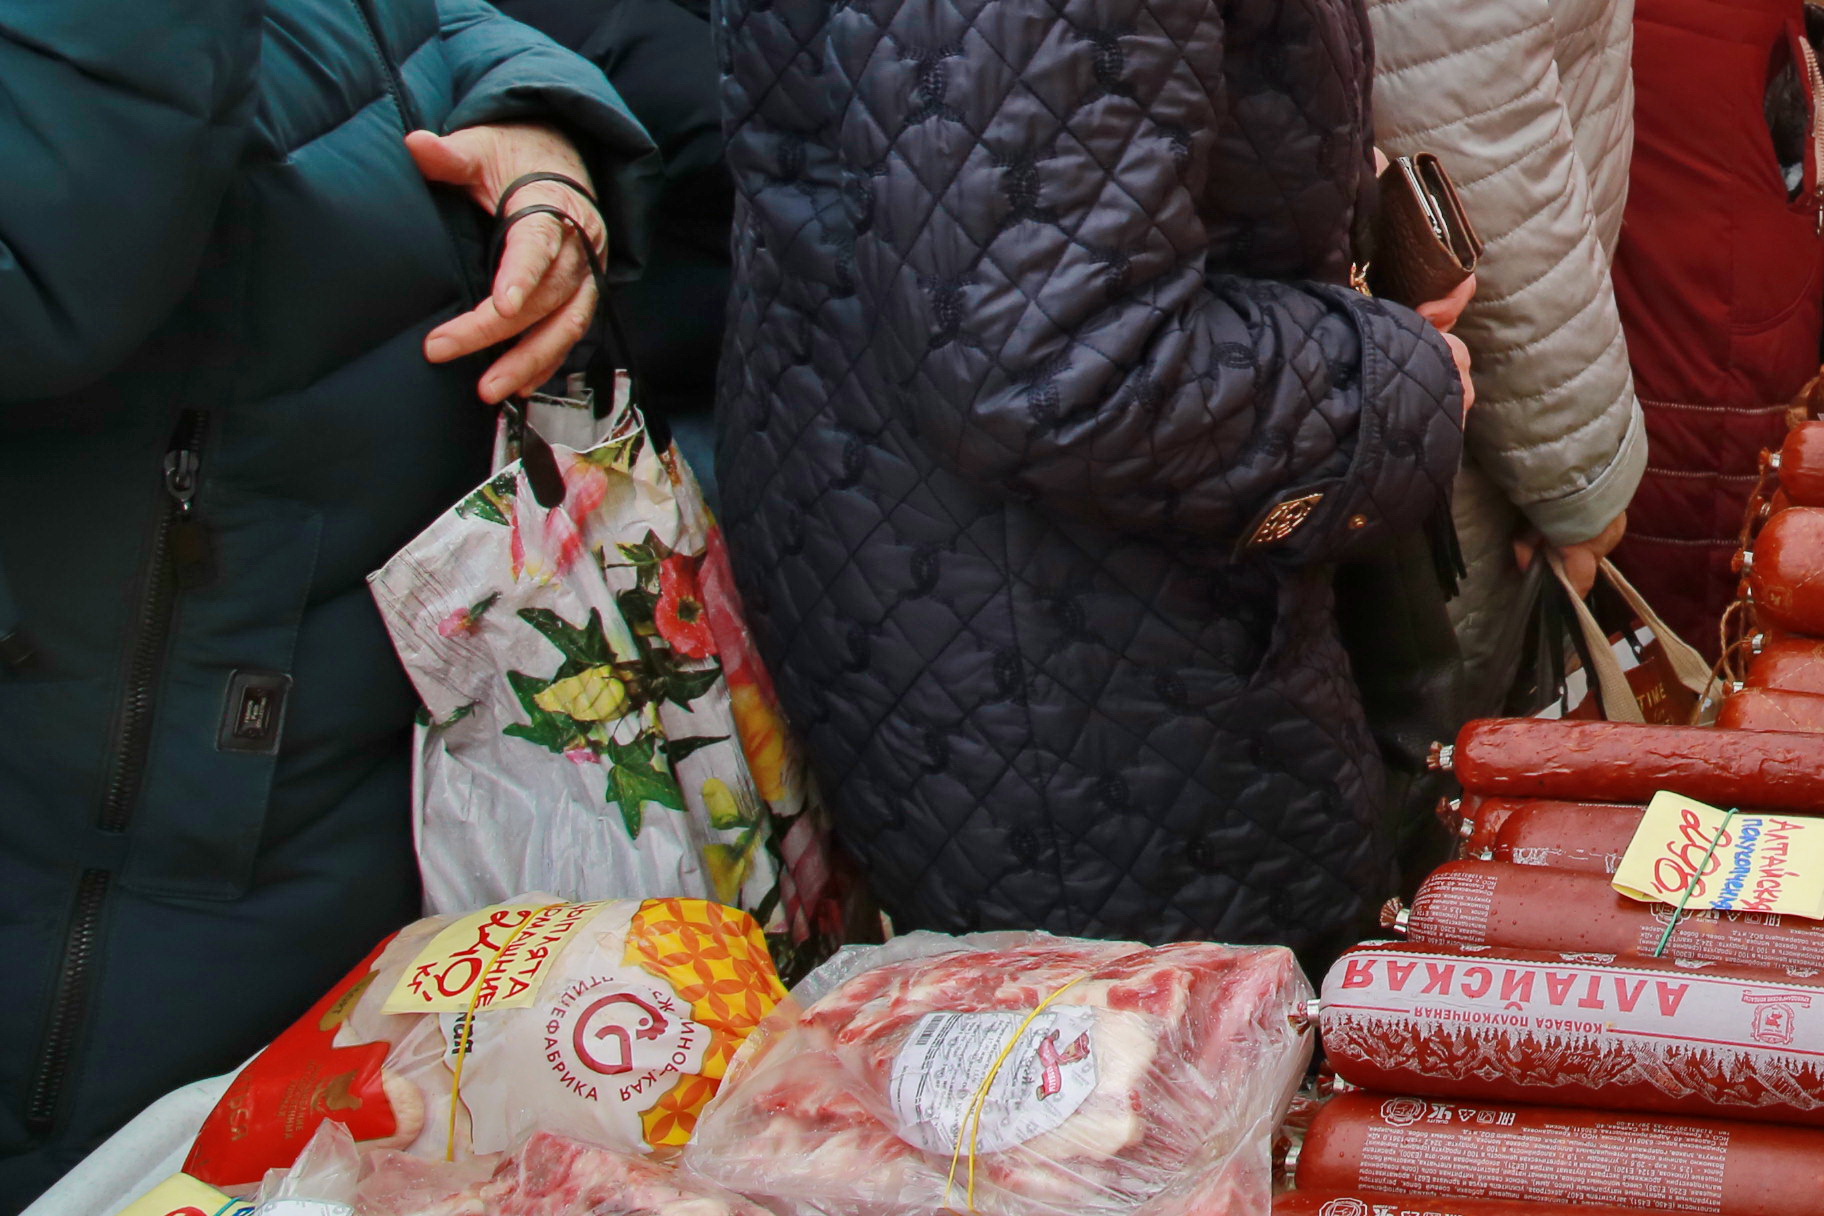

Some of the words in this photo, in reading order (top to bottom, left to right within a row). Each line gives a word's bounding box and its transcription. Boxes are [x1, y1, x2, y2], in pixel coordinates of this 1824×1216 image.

[1341, 958, 1690, 1017] АЛТАЙСКАЯ
[1413, 1006, 1530, 1031] ПОЛУКОПЧЕНАЯ
[1535, 1017, 1604, 1035] КОЛБАСА
